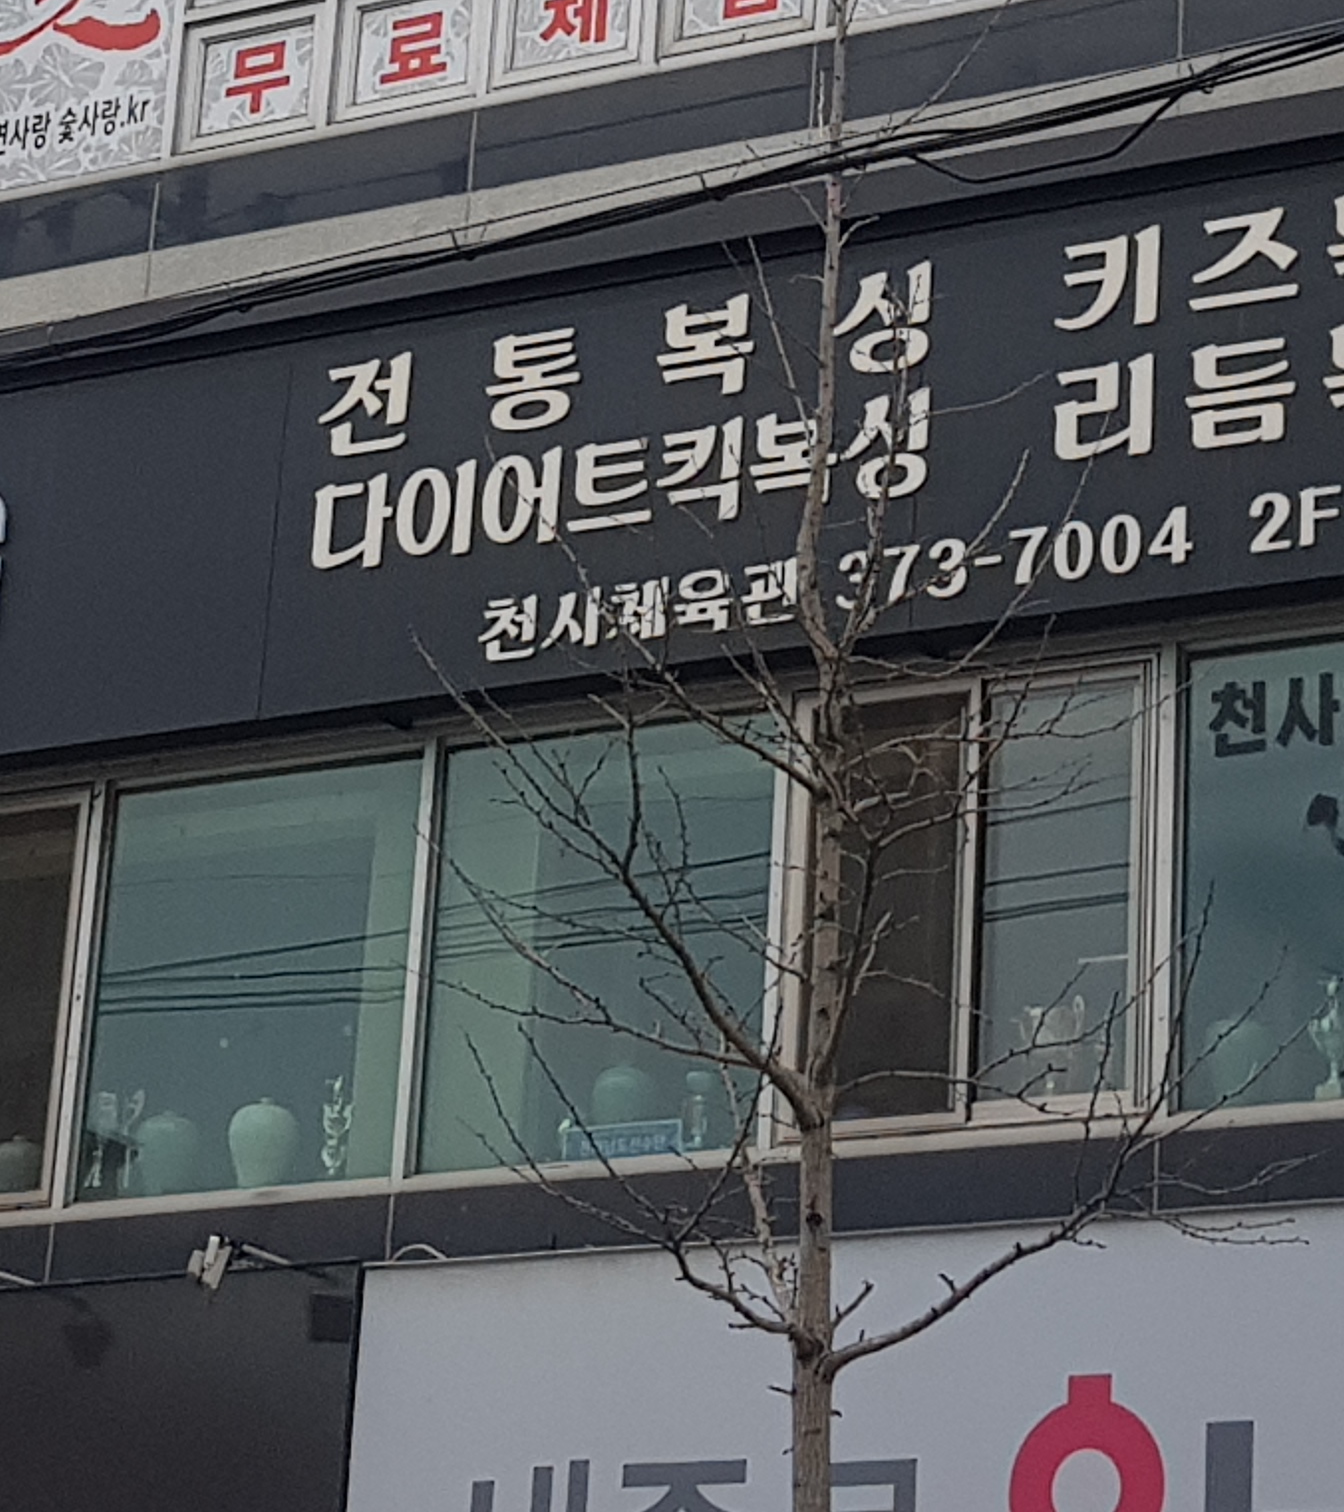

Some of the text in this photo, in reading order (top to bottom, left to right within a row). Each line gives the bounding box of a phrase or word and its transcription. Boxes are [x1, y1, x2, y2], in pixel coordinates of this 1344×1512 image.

[310, 387, 933, 572] 다이어트킥복싱
[835, 506, 1193, 611] 373-7004
[1248, 484, 1342, 554] 2F
